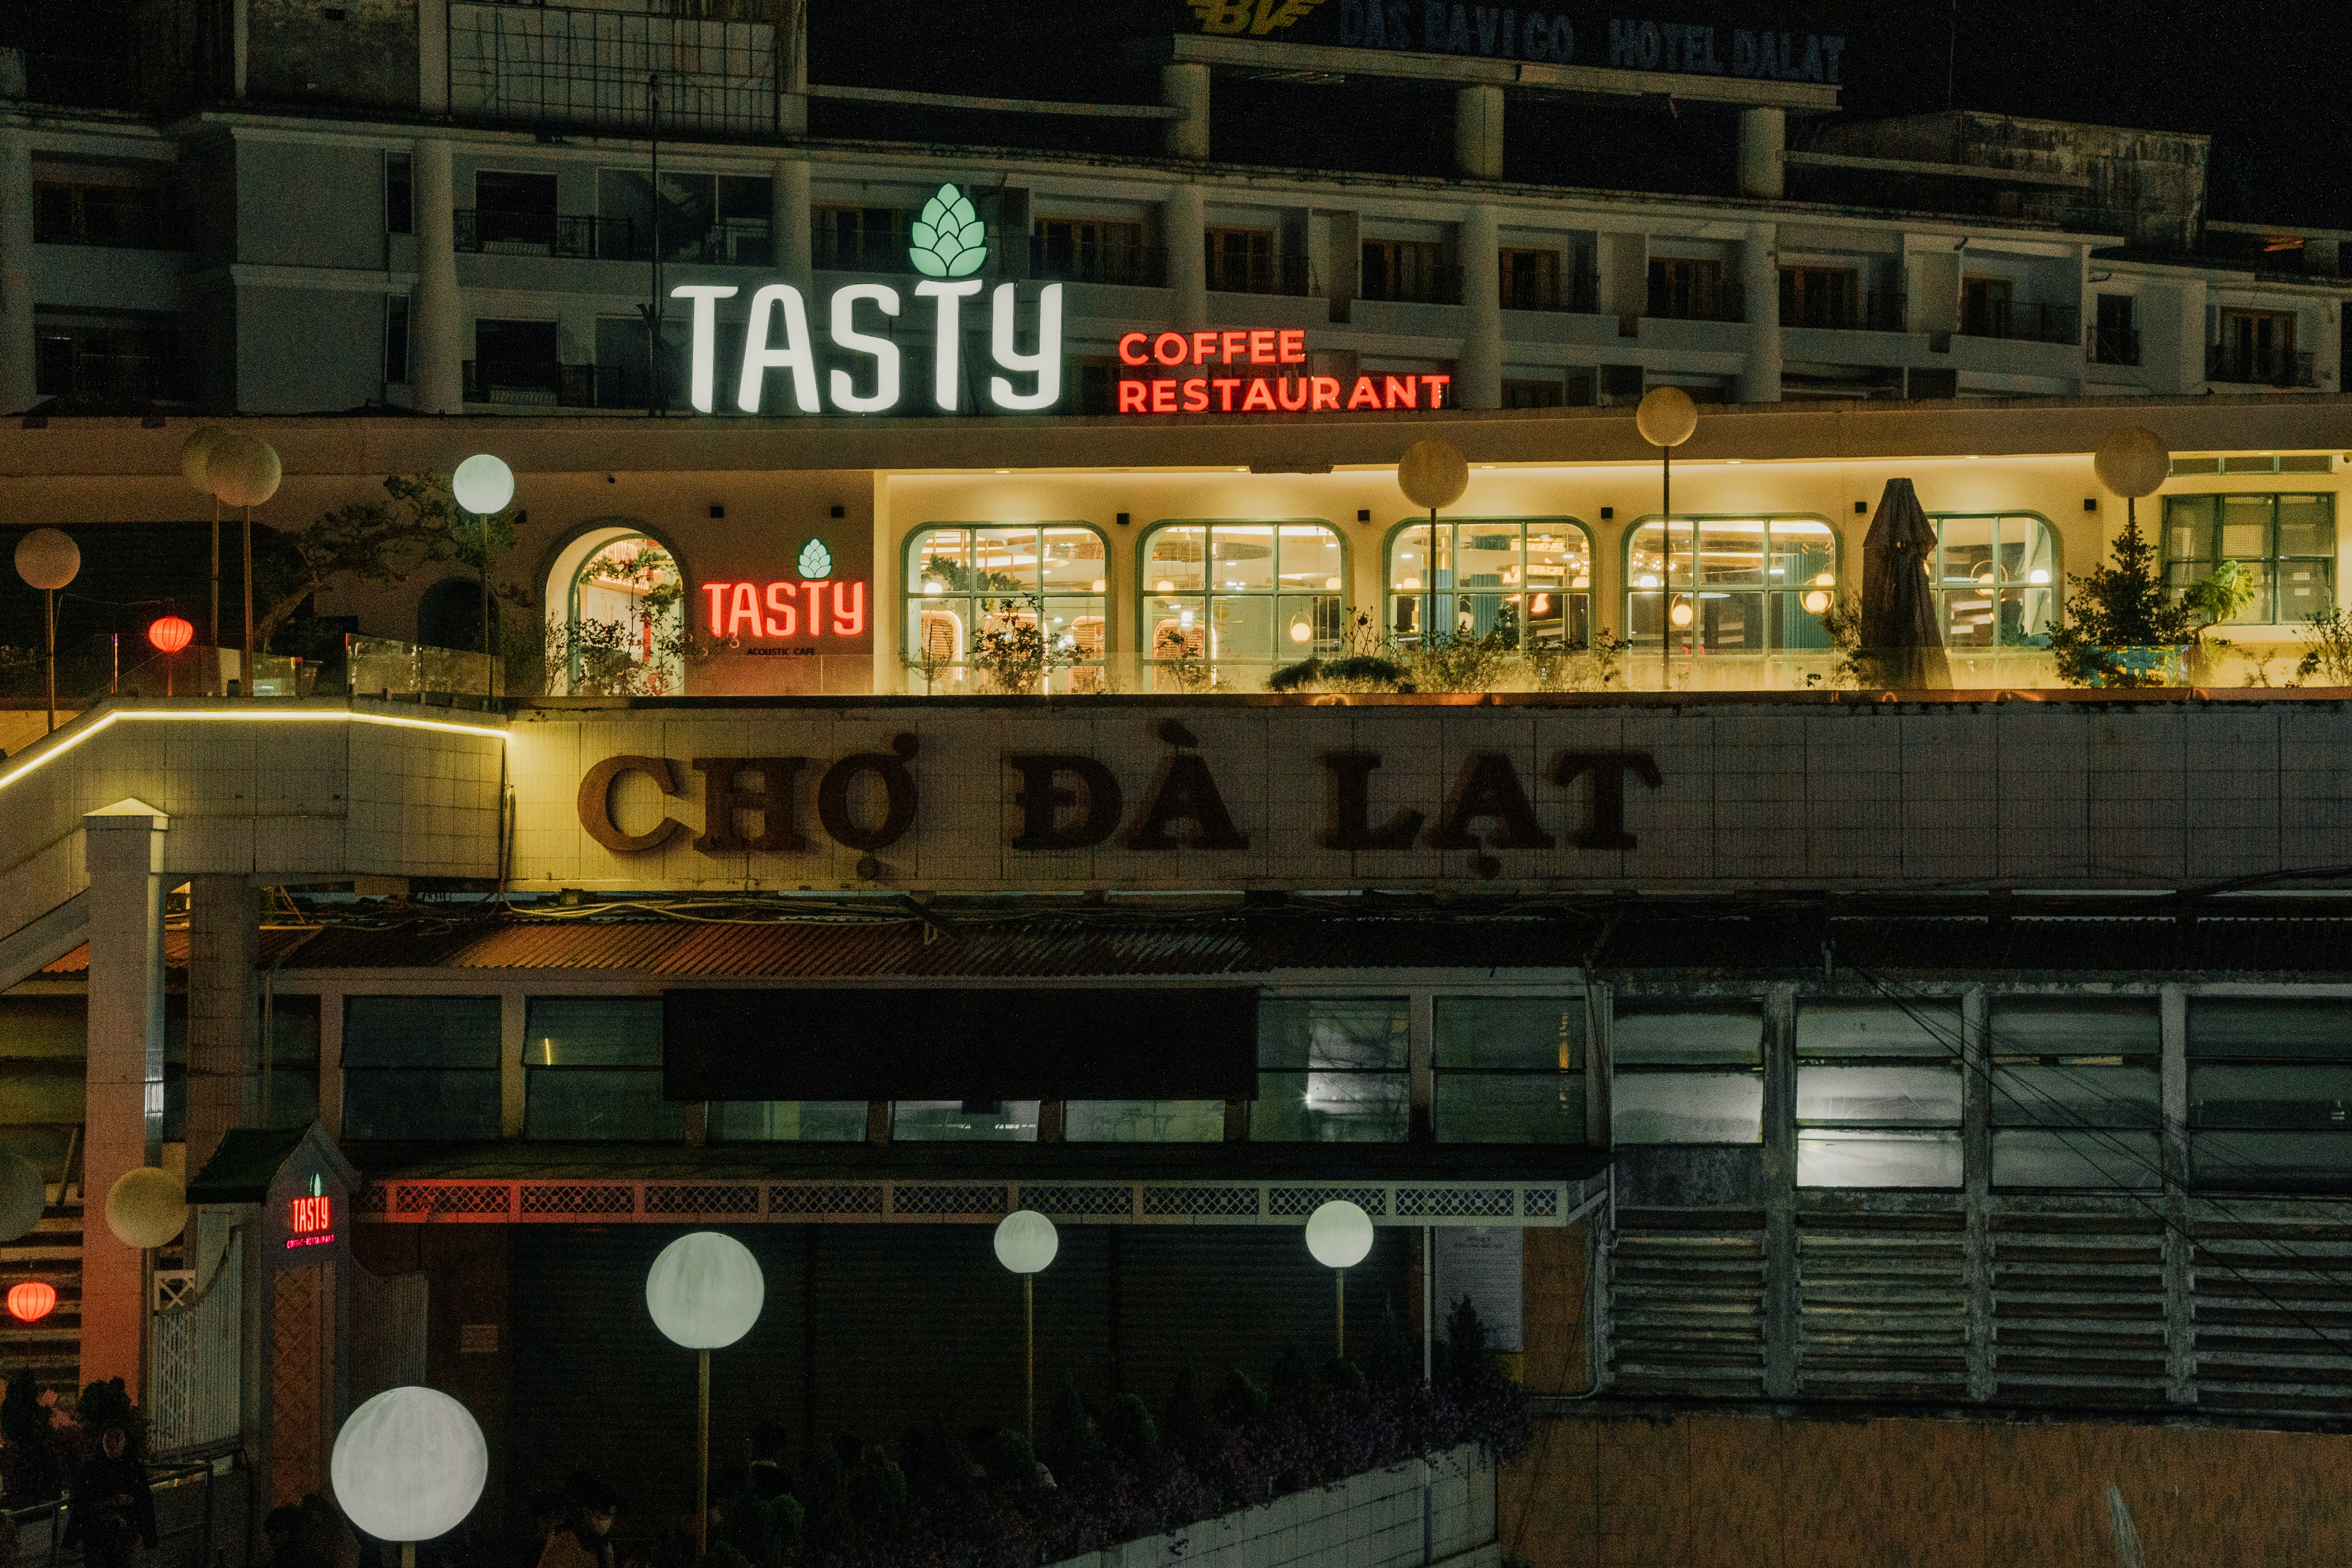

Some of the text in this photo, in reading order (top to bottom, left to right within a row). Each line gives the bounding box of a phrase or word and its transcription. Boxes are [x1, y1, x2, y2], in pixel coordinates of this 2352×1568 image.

[1610, 18, 1723, 74] HOTEL
[1734, 28, 1846, 81] DALAT
[671, 280, 1063, 413] TASTY
[1119, 330, 1305, 366] COFFEE
[1120, 376, 1450, 413] RESTAURANT
[702, 580, 863, 637] TASTY
[577, 719, 1663, 880] CHỢ ĐÀ LẠT
[293, 1197, 329, 1233] TASTY
